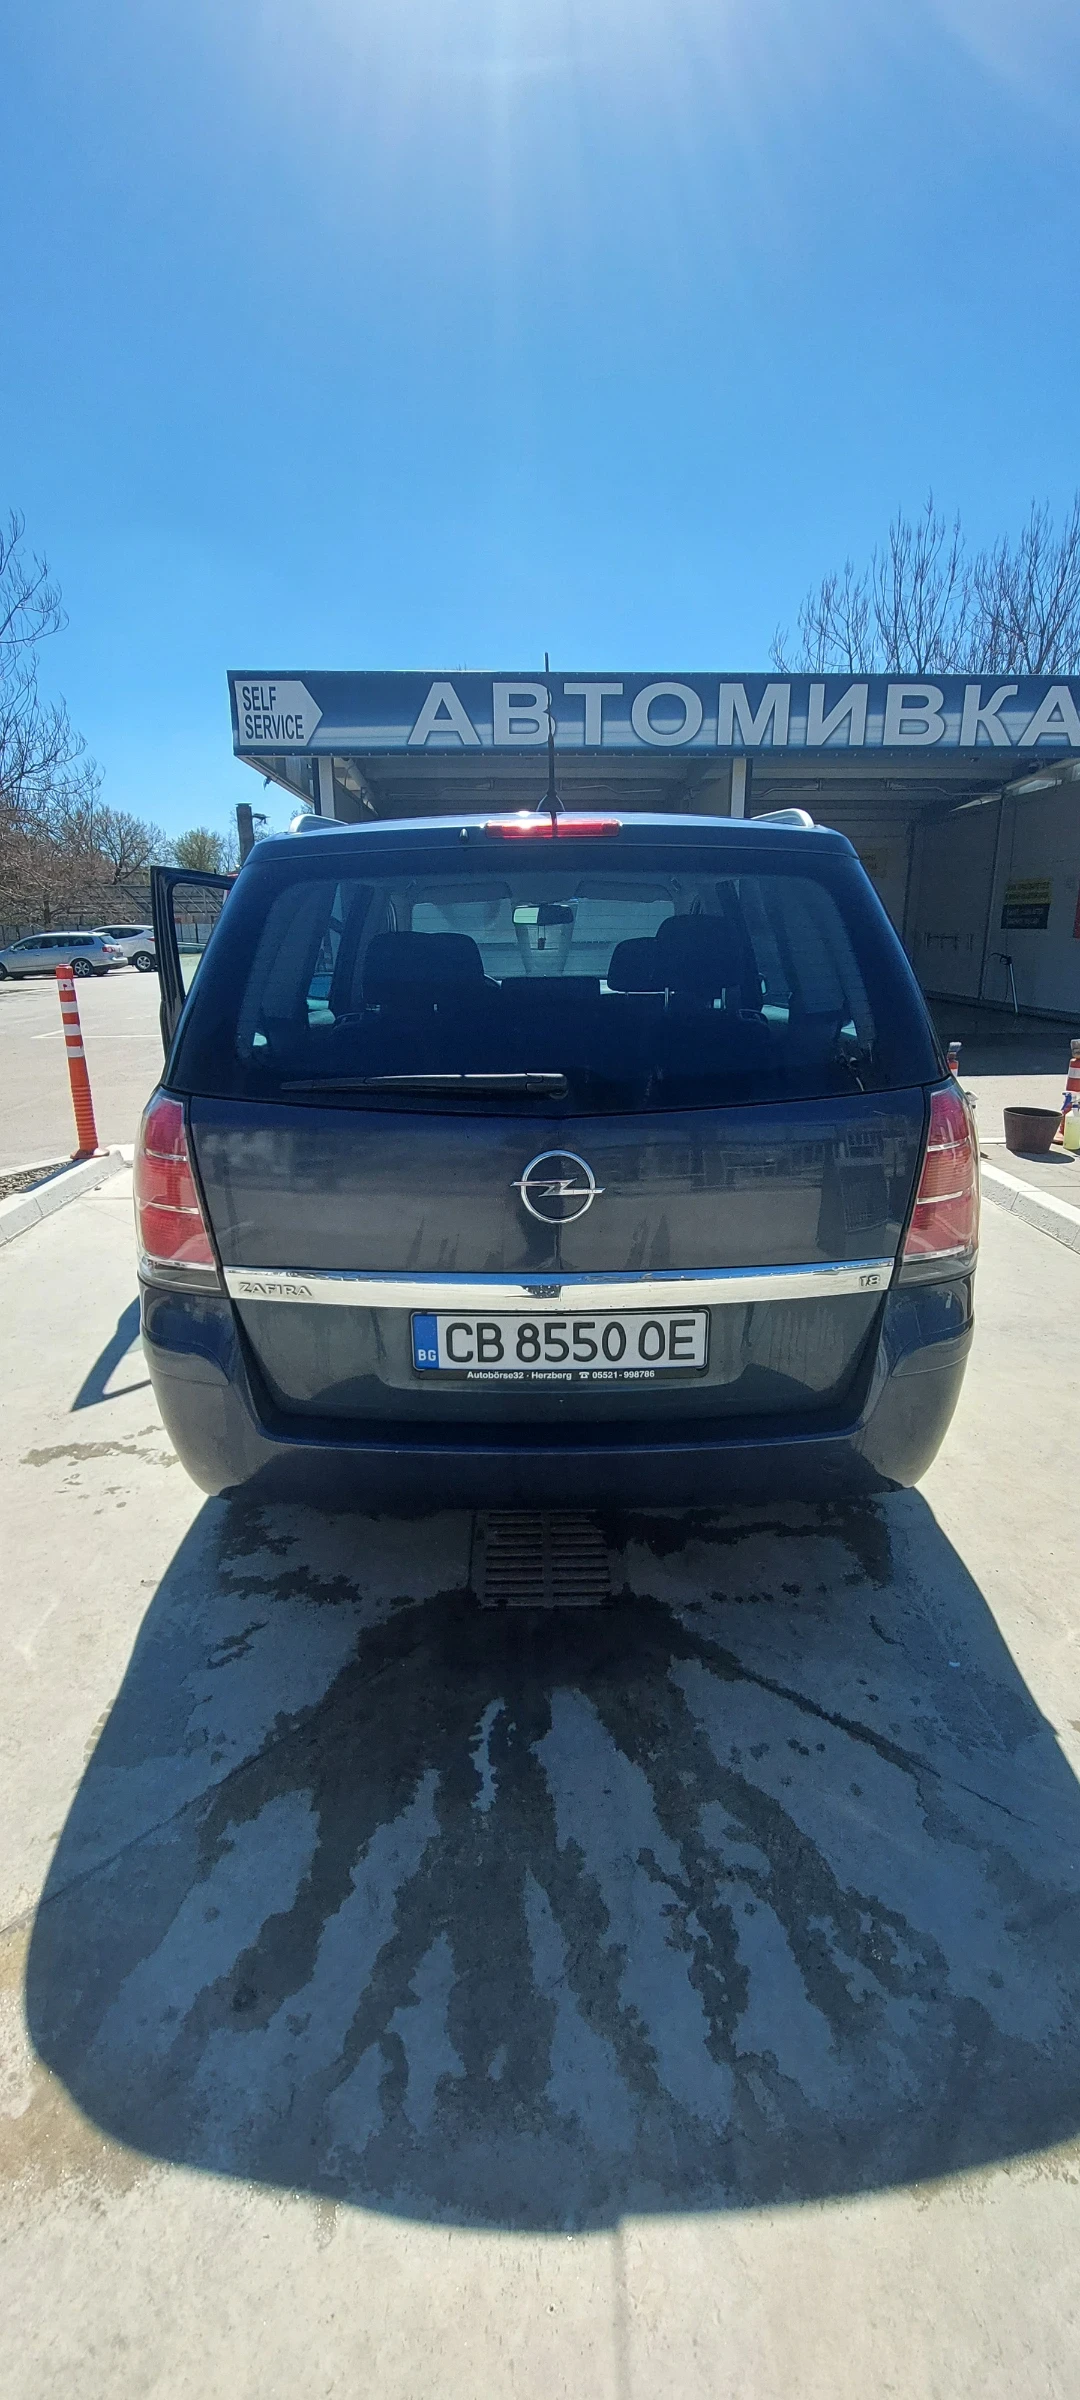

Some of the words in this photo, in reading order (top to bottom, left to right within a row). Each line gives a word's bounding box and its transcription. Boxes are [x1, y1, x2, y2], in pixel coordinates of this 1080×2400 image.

[242, 686, 276, 711] SELF
[408, 681, 1080, 746] АВТОМИВКА
[245, 714, 304, 739] SERVICE
[239, 1281, 313, 1297] ZAFIRA
[445, 1322, 505, 1363] CB
[516, 1321, 626, 1363] 8550
[638, 1319, 696, 1361] OE
[418, 1349, 437, 1361] BG
[467, 1371, 525, 1380] Autobörse32
[531, 1371, 572, 1381] Herzberg
